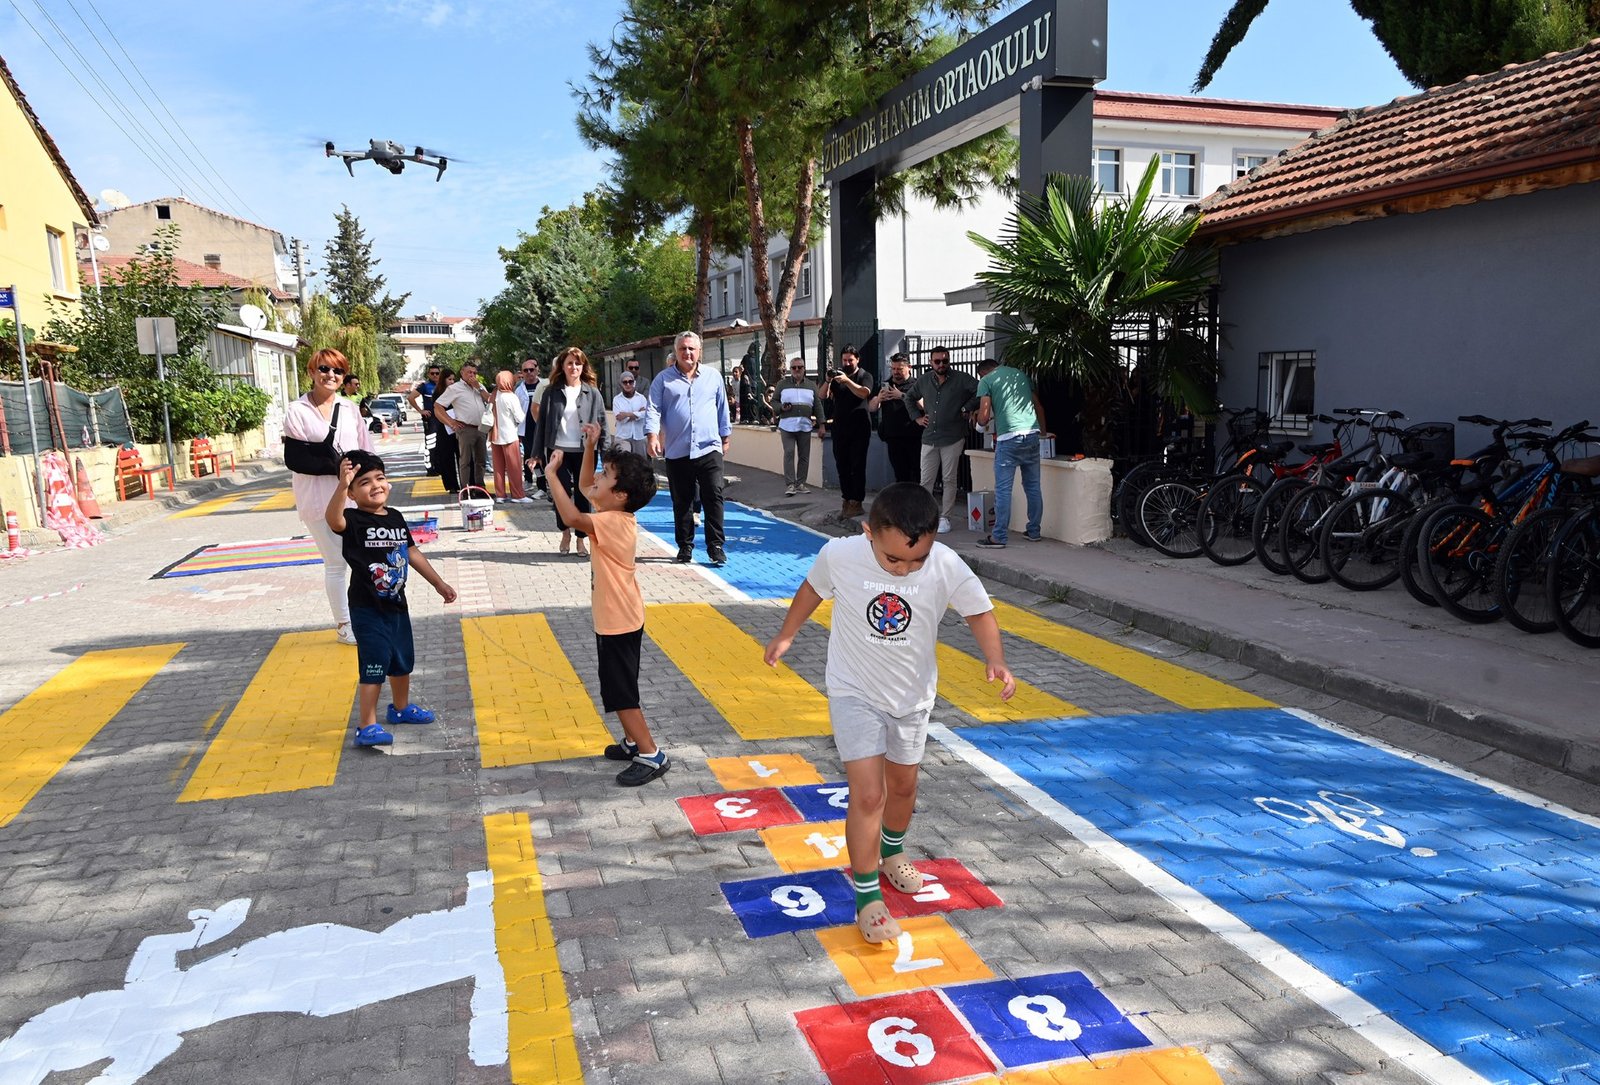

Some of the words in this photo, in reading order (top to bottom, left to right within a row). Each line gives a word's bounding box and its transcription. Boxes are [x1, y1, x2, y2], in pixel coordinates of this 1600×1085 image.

[824, 127, 877, 173] ZÜBEYDE
[879, 84, 931, 144] HANIM
[934, 11, 1052, 115] ORTAOKULU
[366, 527, 408, 540] SONIC
[864, 581, 919, 595] SPIDER-MAN
[748, 760, 779, 778] 1
[713, 796, 759, 818] 3
[803, 831, 847, 859] 4
[891, 931, 944, 973] 7
[1007, 994, 1083, 1042] 8
